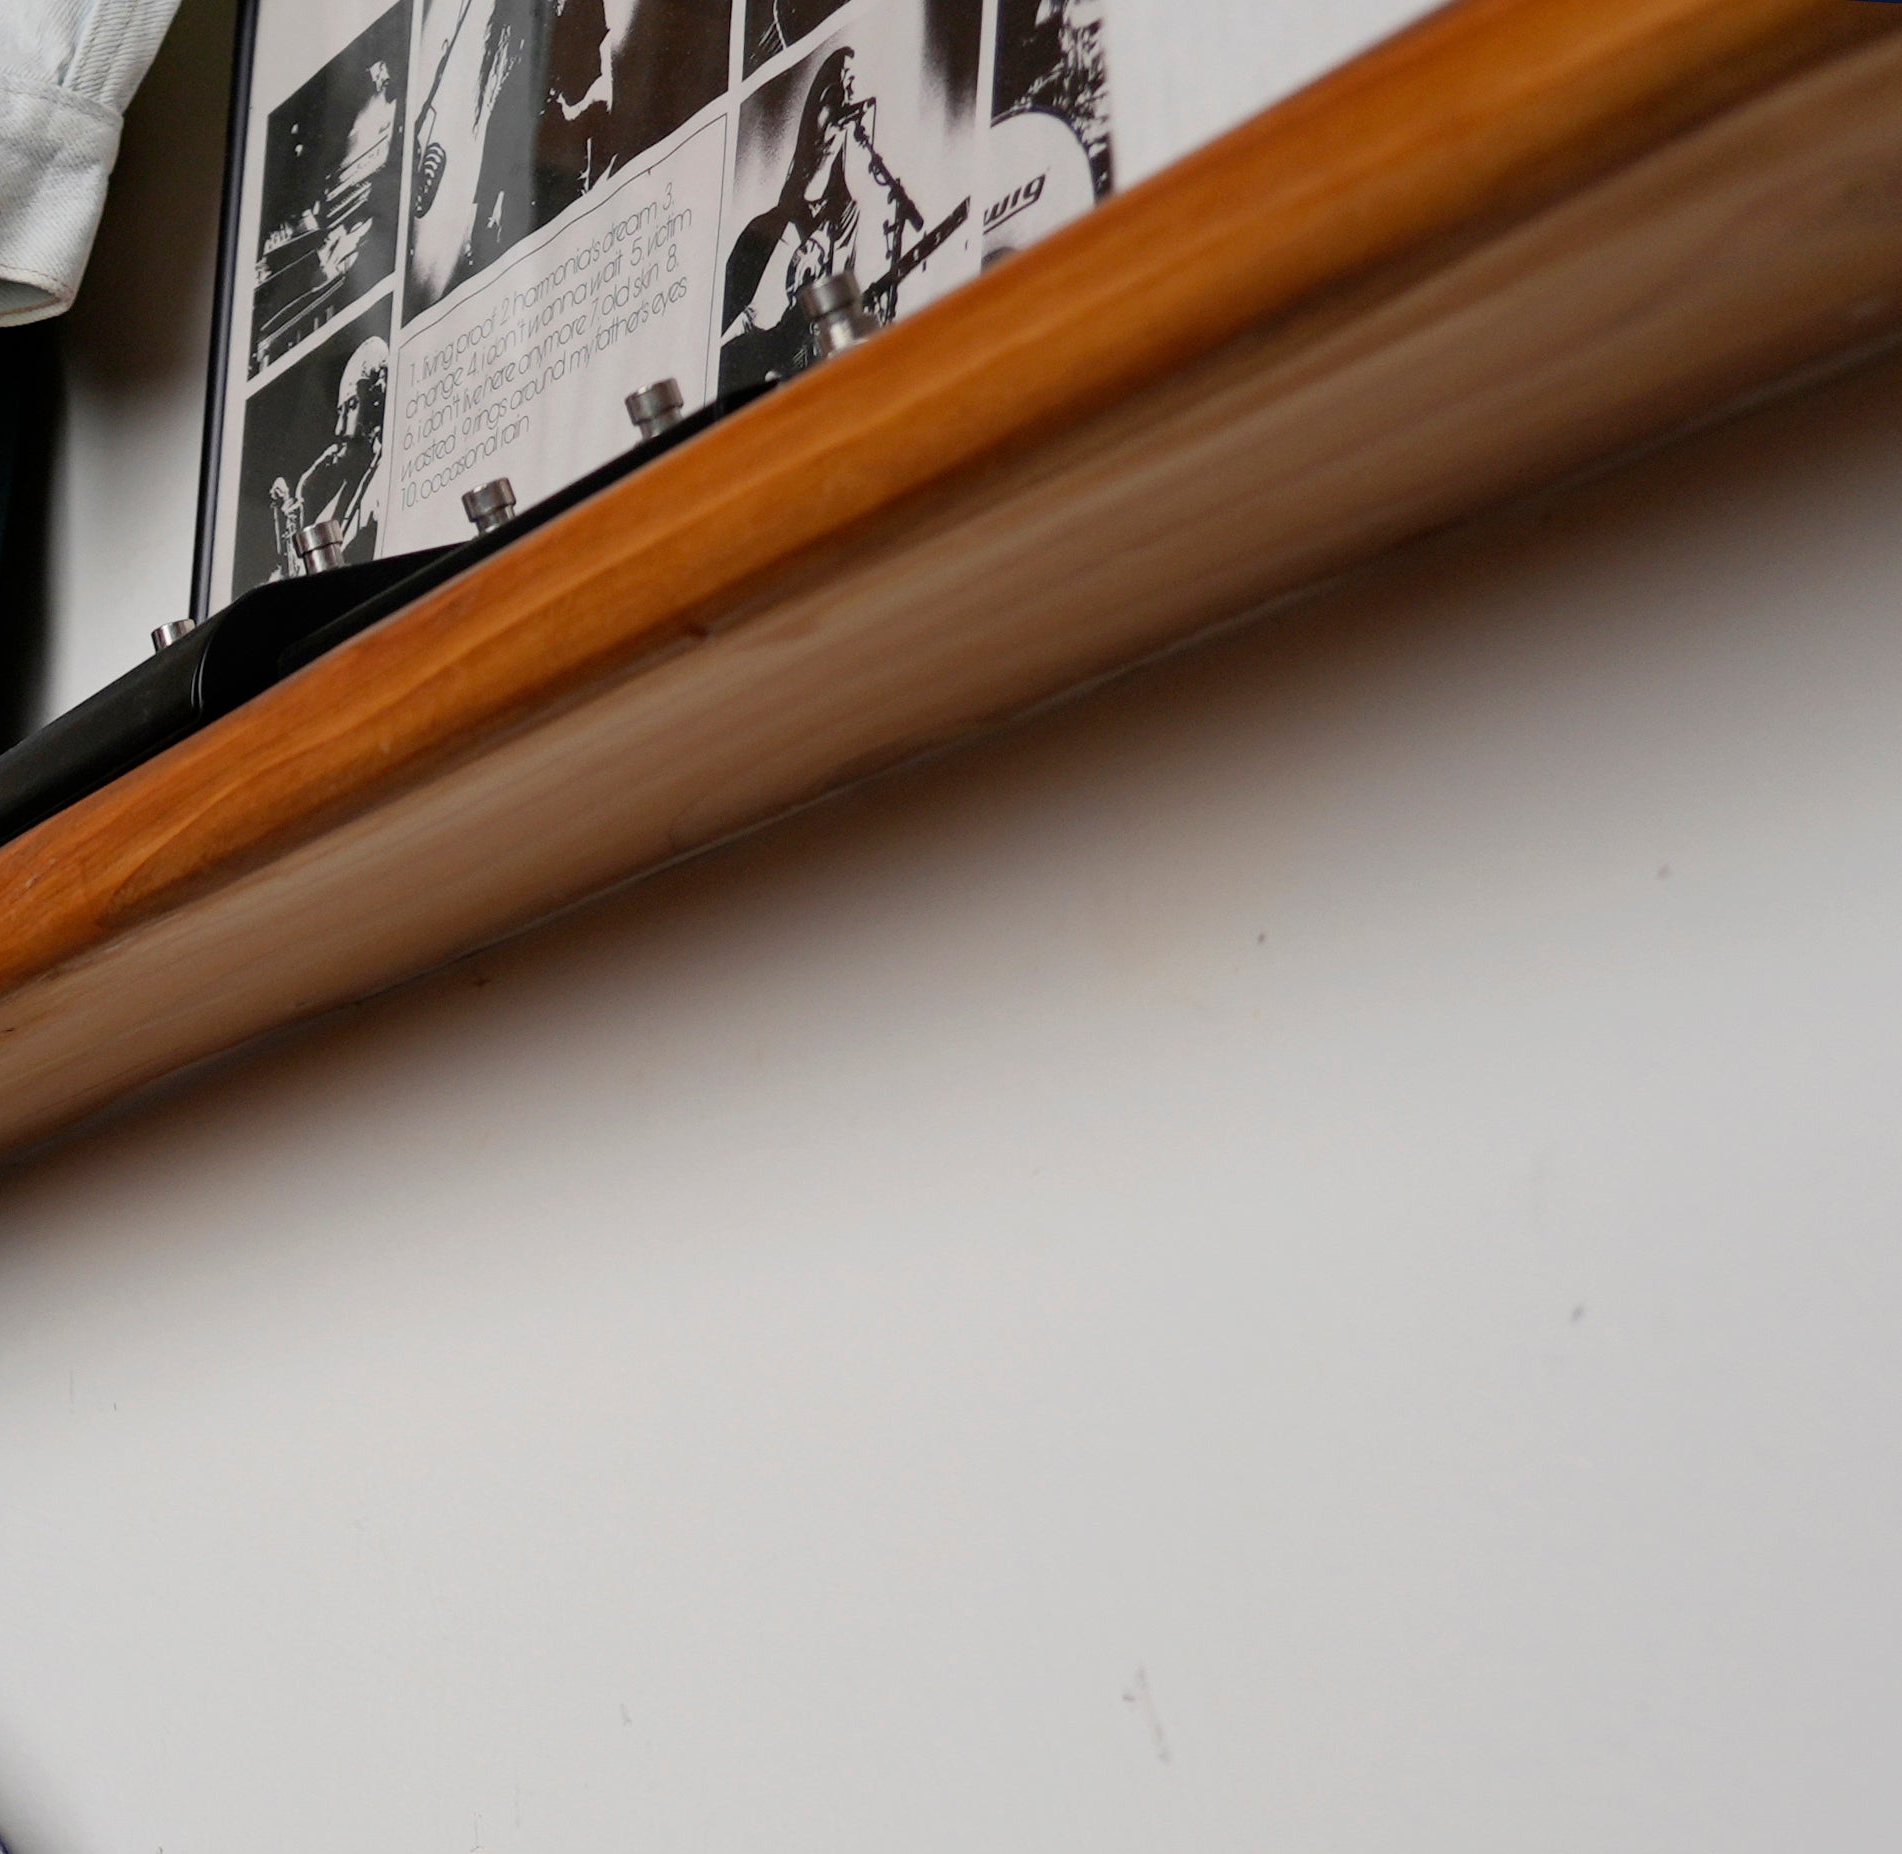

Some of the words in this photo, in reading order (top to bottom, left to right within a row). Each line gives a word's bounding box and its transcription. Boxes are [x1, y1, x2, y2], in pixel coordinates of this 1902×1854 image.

[400, 424, 457, 482] wasted
[473, 397, 507, 437] rings
[510, 350, 566, 410] around
[569, 338, 595, 374] my
[594, 299, 649, 354] father's
[651, 276, 688, 316] eyes
[405, 366, 464, 419] change
[486, 318, 526, 366] don't
[527, 281, 588, 339] wanna
[590, 249, 623, 297] wait
[647, 208, 693, 257] victim
[422, 343, 454, 380] living
[455, 306, 497, 362] proof
[512, 238, 601, 316] harmonia's
[602, 201, 658, 253] dream
[662, 181, 675, 211] 3.
[422, 394, 461, 438] don't
[463, 385, 483, 414] live
[483, 362, 516, 398] here
[518, 314, 587, 375] anymore
[601, 275, 631, 316] old
[633, 262, 659, 298] skin
[500, 414, 530, 448] rain
